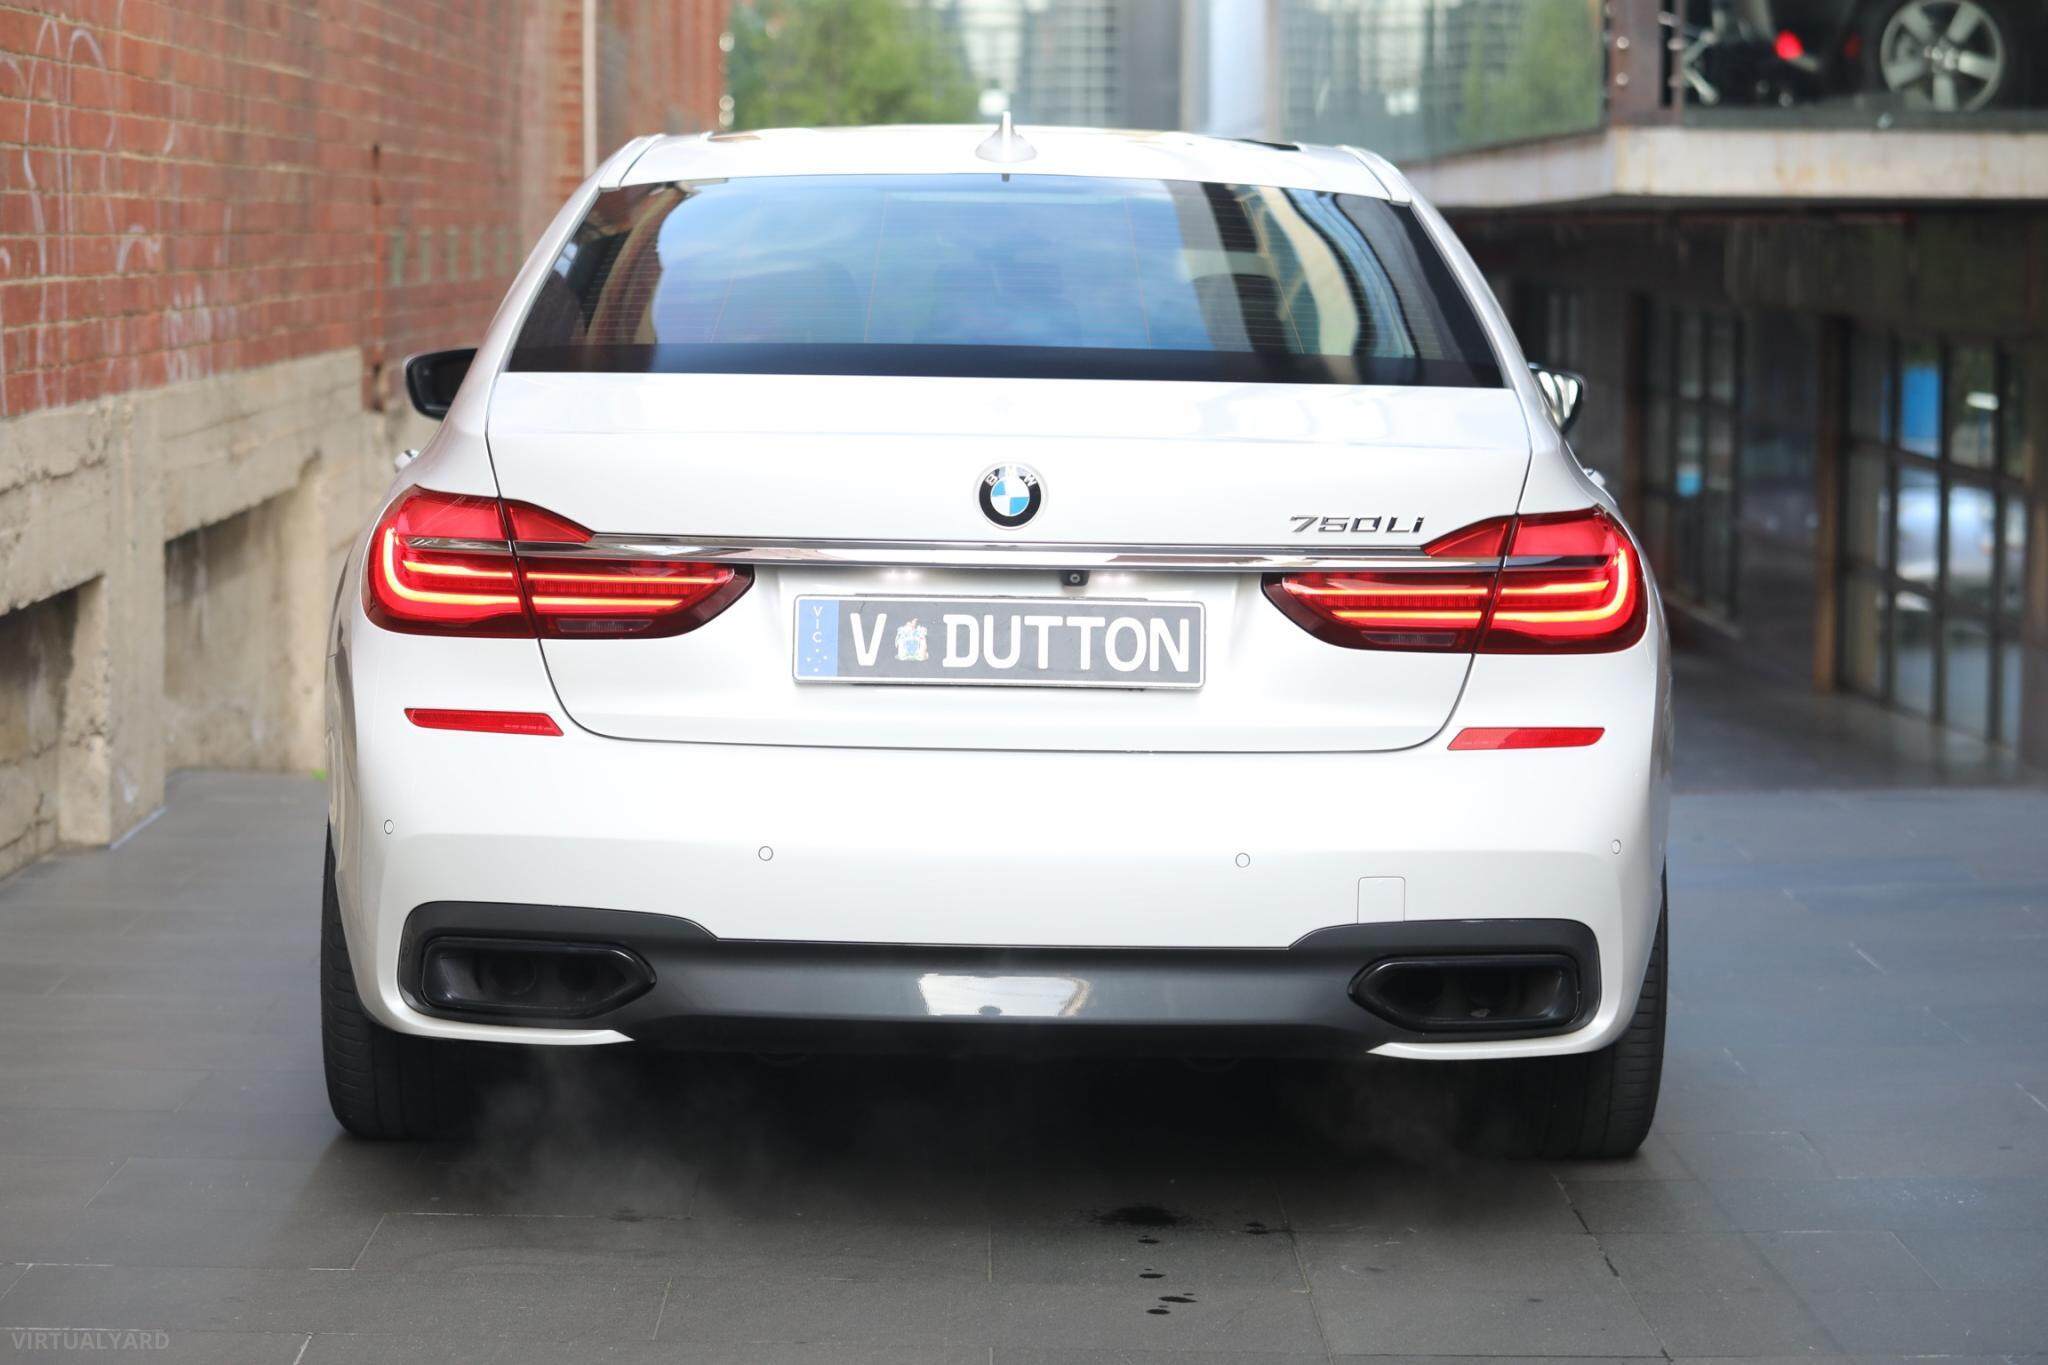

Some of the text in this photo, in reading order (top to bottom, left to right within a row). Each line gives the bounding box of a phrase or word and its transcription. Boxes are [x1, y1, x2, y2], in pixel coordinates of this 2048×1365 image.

[1290, 516, 1425, 533] 750Li
[812, 606, 823, 643] VIC
[850, 613, 1190, 672] V DUTTON
